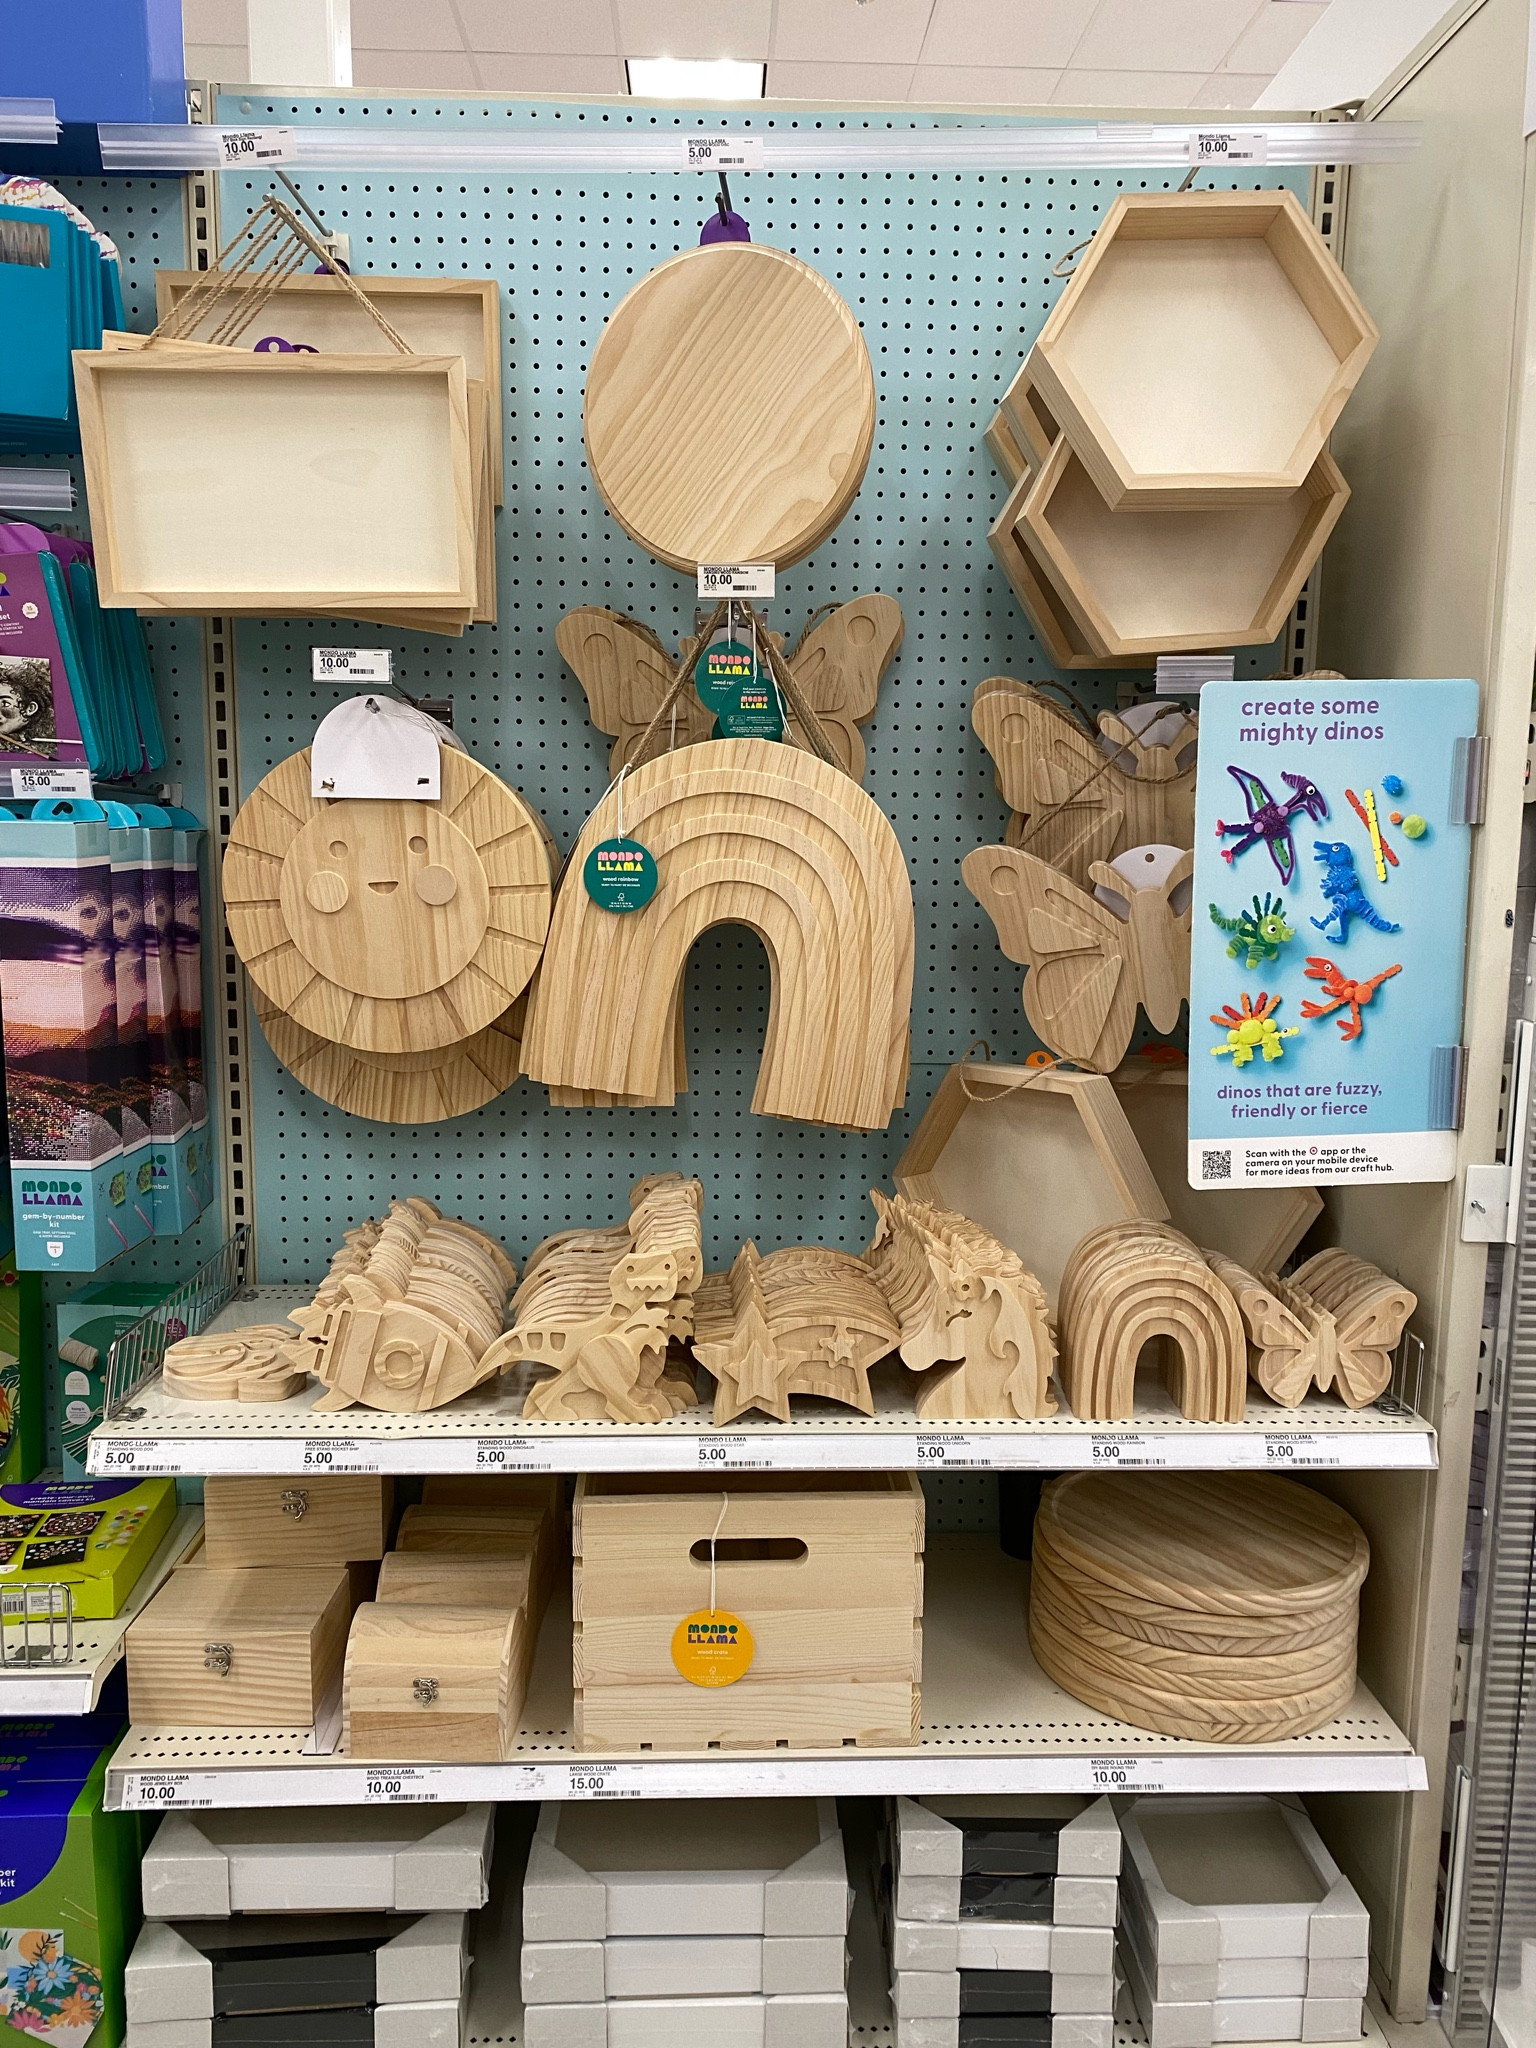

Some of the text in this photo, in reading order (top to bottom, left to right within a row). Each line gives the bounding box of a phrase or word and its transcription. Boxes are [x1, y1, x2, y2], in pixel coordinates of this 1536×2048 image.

[224, 140, 254, 154] 10.00
[689, 147, 712, 158] 5.00
[1199, 141, 1228, 152] 10.00
[704, 575, 732, 585] 10.00
[320, 657, 349, 668] 10.00
[708, 654, 751, 665] MONDO
[708, 664, 751, 675] LLAMA
[1241, 699, 1380, 716] create some
[1239, 720, 1385, 746] mighty dinos
[21, 776, 50, 786] 15.00
[597, 851, 644, 861] MONDO
[597, 861, 644, 871] LLAMA
[1217, 1081, 1383, 1099] dinos that are fuzzy,
[1231, 1102, 1368, 1120] friendly or fierce
[1245, 1150, 1267, 1158] Scan
[1270, 1149, 1290, 1157] with
[1292, 1149, 1307, 1157] the
[1320, 1148, 1339, 1157] app
[1351, 1146, 1366, 1154] the
[1245, 1159, 1280, 1167] camera
[1295, 1158, 1316, 1167] your
[1317, 1156, 1348, 1165] mobile
[1349, 1156, 1379, 1164] device
[1245, 1168, 1259, 1176] for
[1260, 1168, 1284, 1176] more
[1285, 1166, 1310, 1175] ideas
[1312, 1166, 1333, 1174] from
[1351, 1164, 1374, 1173] craft
[1375, 1164, 1394, 1172] hub.
[21, 1180, 83, 1193] MONDO
[22, 1193, 83, 1206] LLAMA
[22, 1212, 86, 1221] gem-by-number
[49, 1220, 60, 1228] kit
[476, 1451, 505, 1463] 5.00
[698, 1448, 726, 1460] 5.00
[917, 1446, 945, 1458] 5.00
[1092, 1446, 1120, 1458] 5.00
[1266, 1446, 1294, 1457] 5.00
[105, 1452, 135, 1464] 5.00
[304, 1452, 333, 1464] 5.00
[688, 1624, 738, 1634] MONDO
[688, 1634, 738, 1644] LLAMA
[570, 1777, 604, 1789] 15.00
[1093, 1771, 1126, 1783] 10.00
[140, 1787, 175, 1799] 10.00
[367, 1781, 401, 1794] 10.00
[0, 1879, 16, 1888] kit
